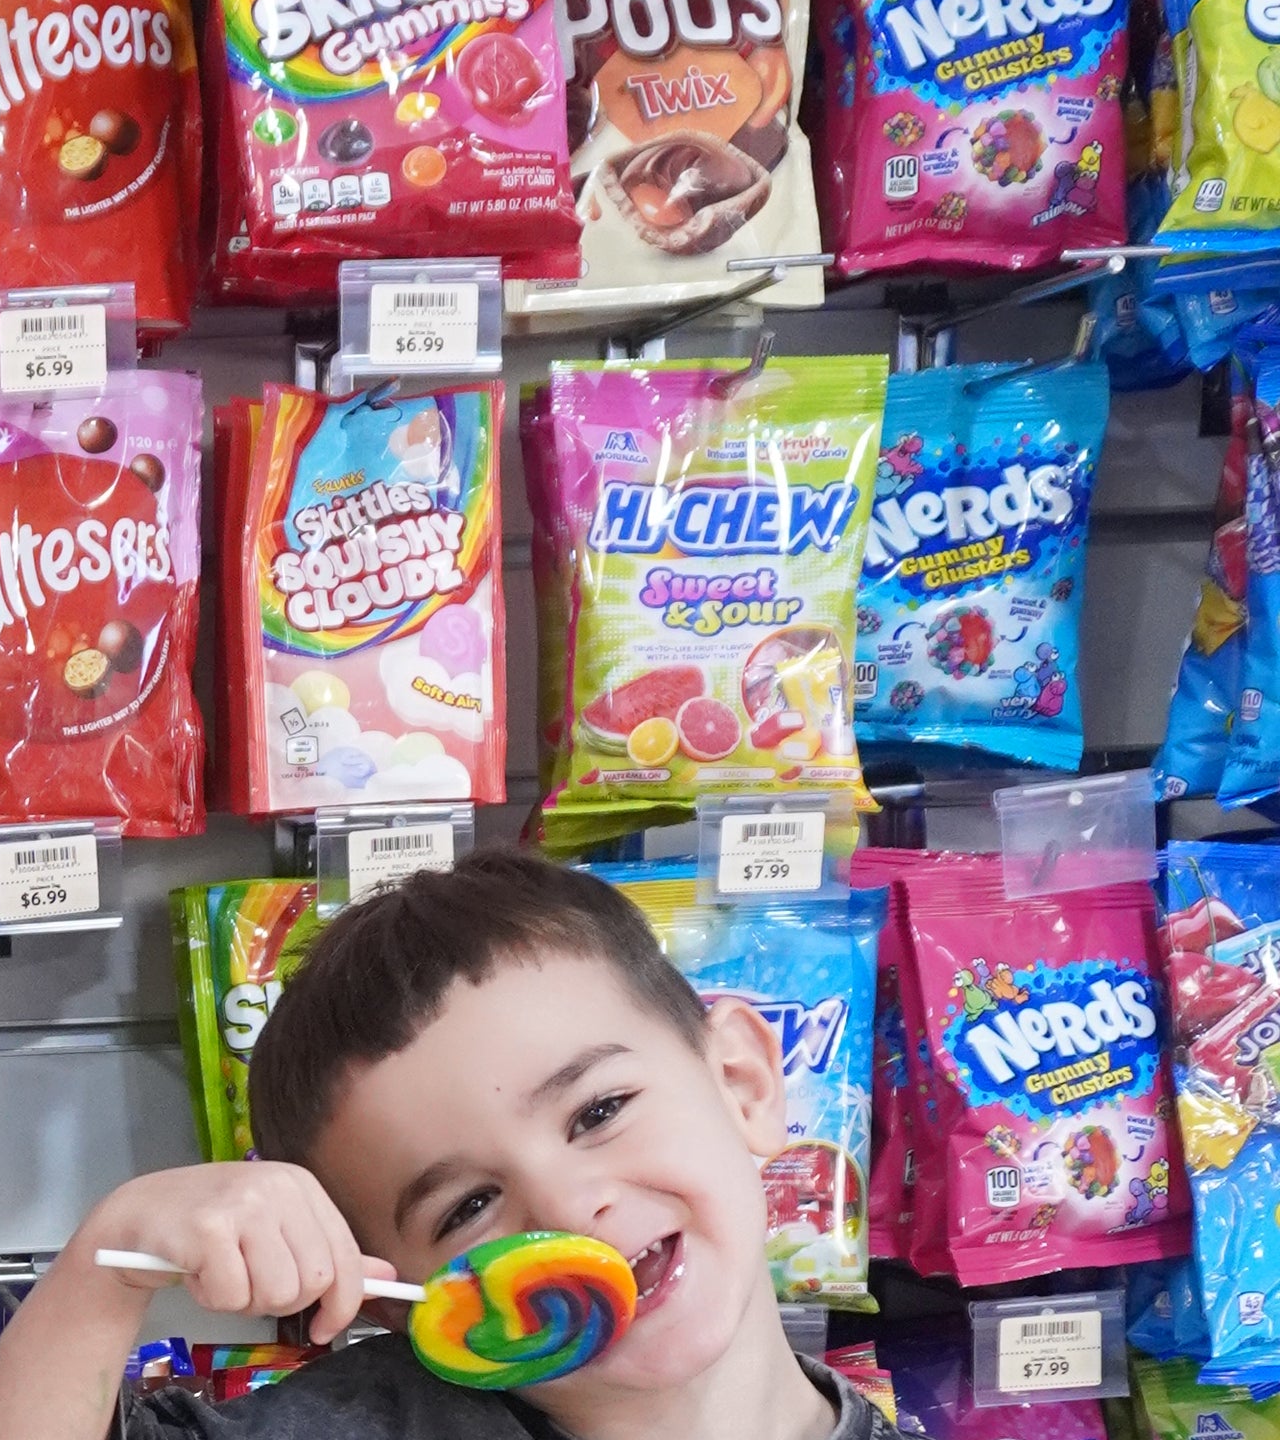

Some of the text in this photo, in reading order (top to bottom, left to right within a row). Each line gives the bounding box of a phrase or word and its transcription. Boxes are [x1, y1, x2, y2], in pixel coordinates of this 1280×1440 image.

[630, 68, 739, 120] Twix
[395, 336, 443, 355] $6.99
[26, 359, 73, 379] $6.99
[295, 481, 433, 547] Skittles
[277, 514, 466, 591] SQUISHY
[286, 551, 465, 633] CLOUDZ
[639, 567, 778, 610] Sweet
[603, 771, 661, 780] WATERMELON
[743, 863, 789, 882] $7.99
[1026, 1051, 1111, 1096] Gummy
[1049, 1063, 1134, 1107] Clusters
[1023, 1360, 1070, 1379] $7.99
